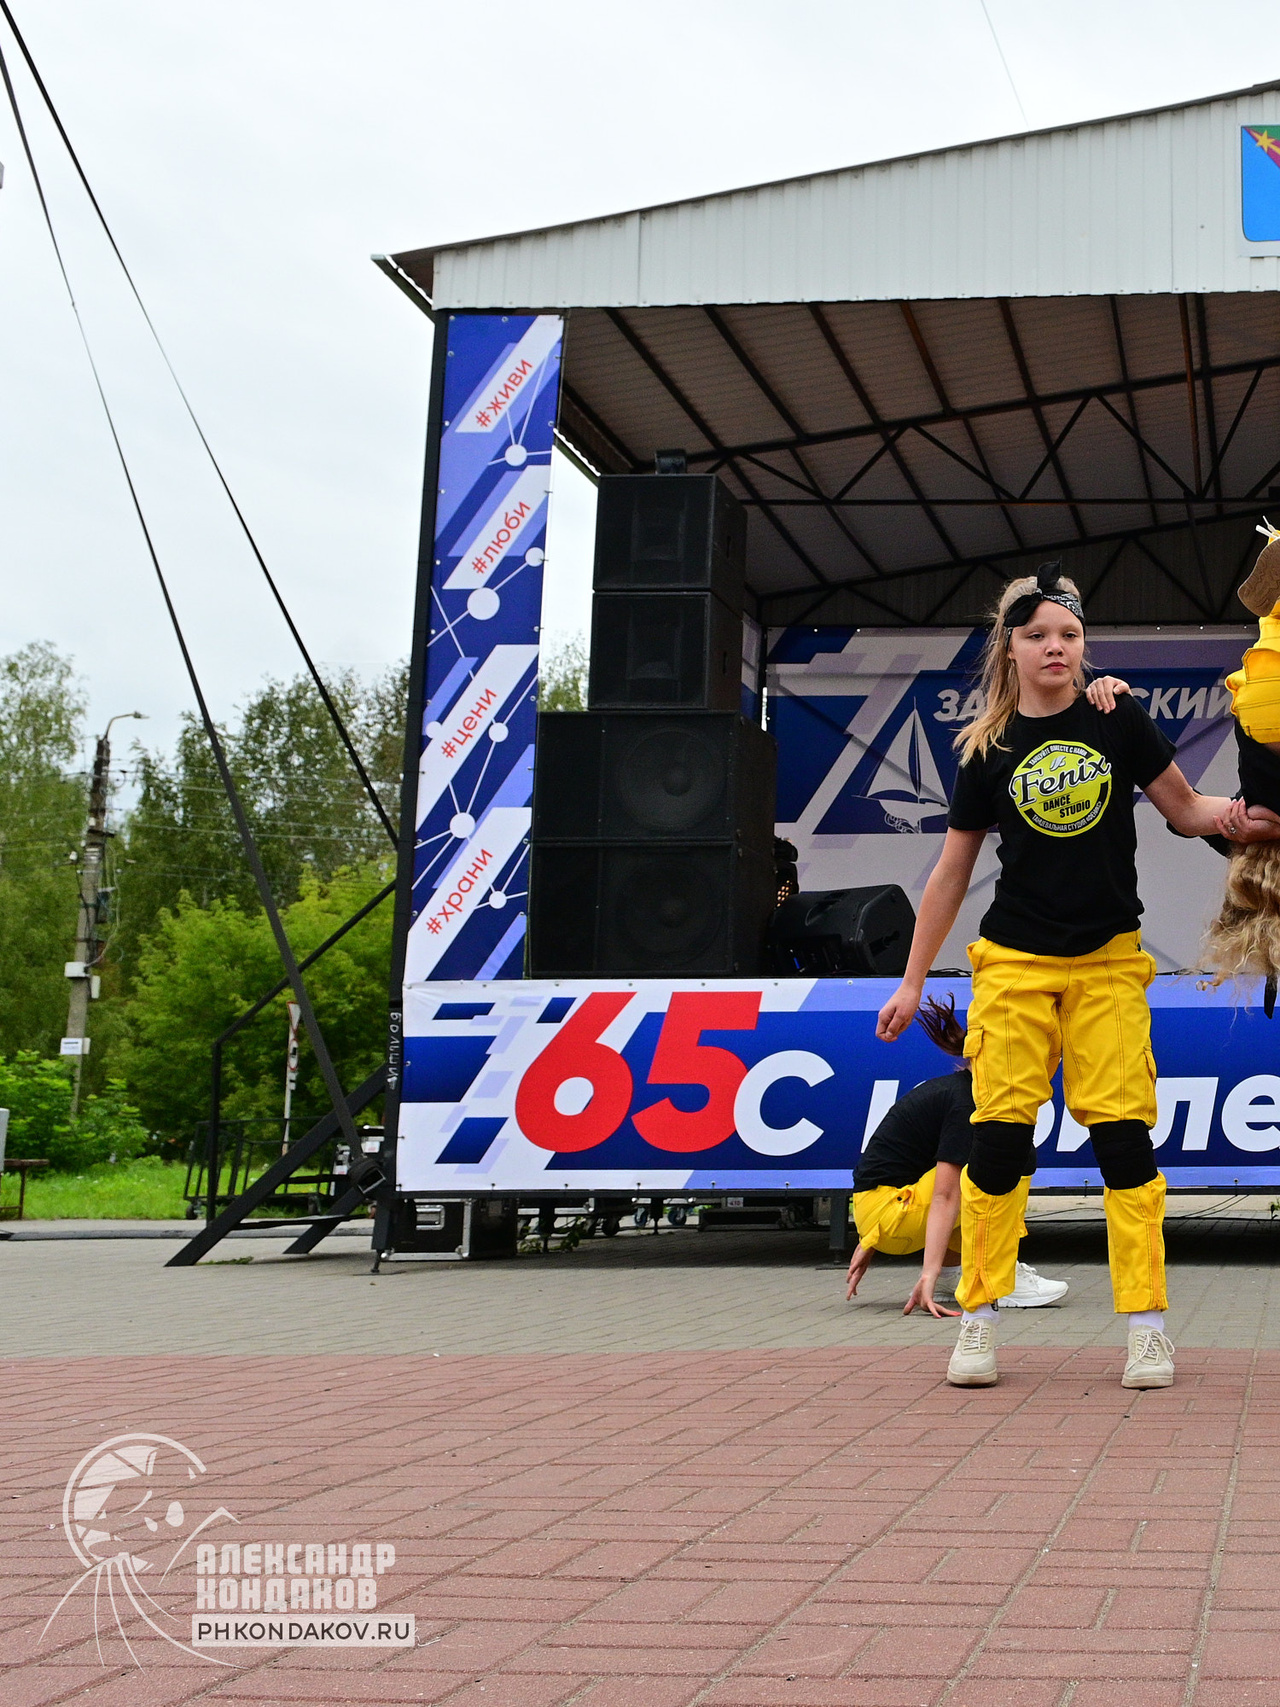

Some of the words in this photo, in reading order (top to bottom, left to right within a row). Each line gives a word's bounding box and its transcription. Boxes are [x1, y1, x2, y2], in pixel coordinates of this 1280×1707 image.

[477, 358, 533, 427] #живи
[473, 501, 531, 574] #люби
[441, 687, 498, 759] #цени
[1008, 755, 1112, 808] Fenix
[1043, 794, 1071, 812] DANCE
[1059, 800, 1091, 818] STUDIO
[427, 847, 494, 934] #храни
[514, 990, 763, 1154] 65
